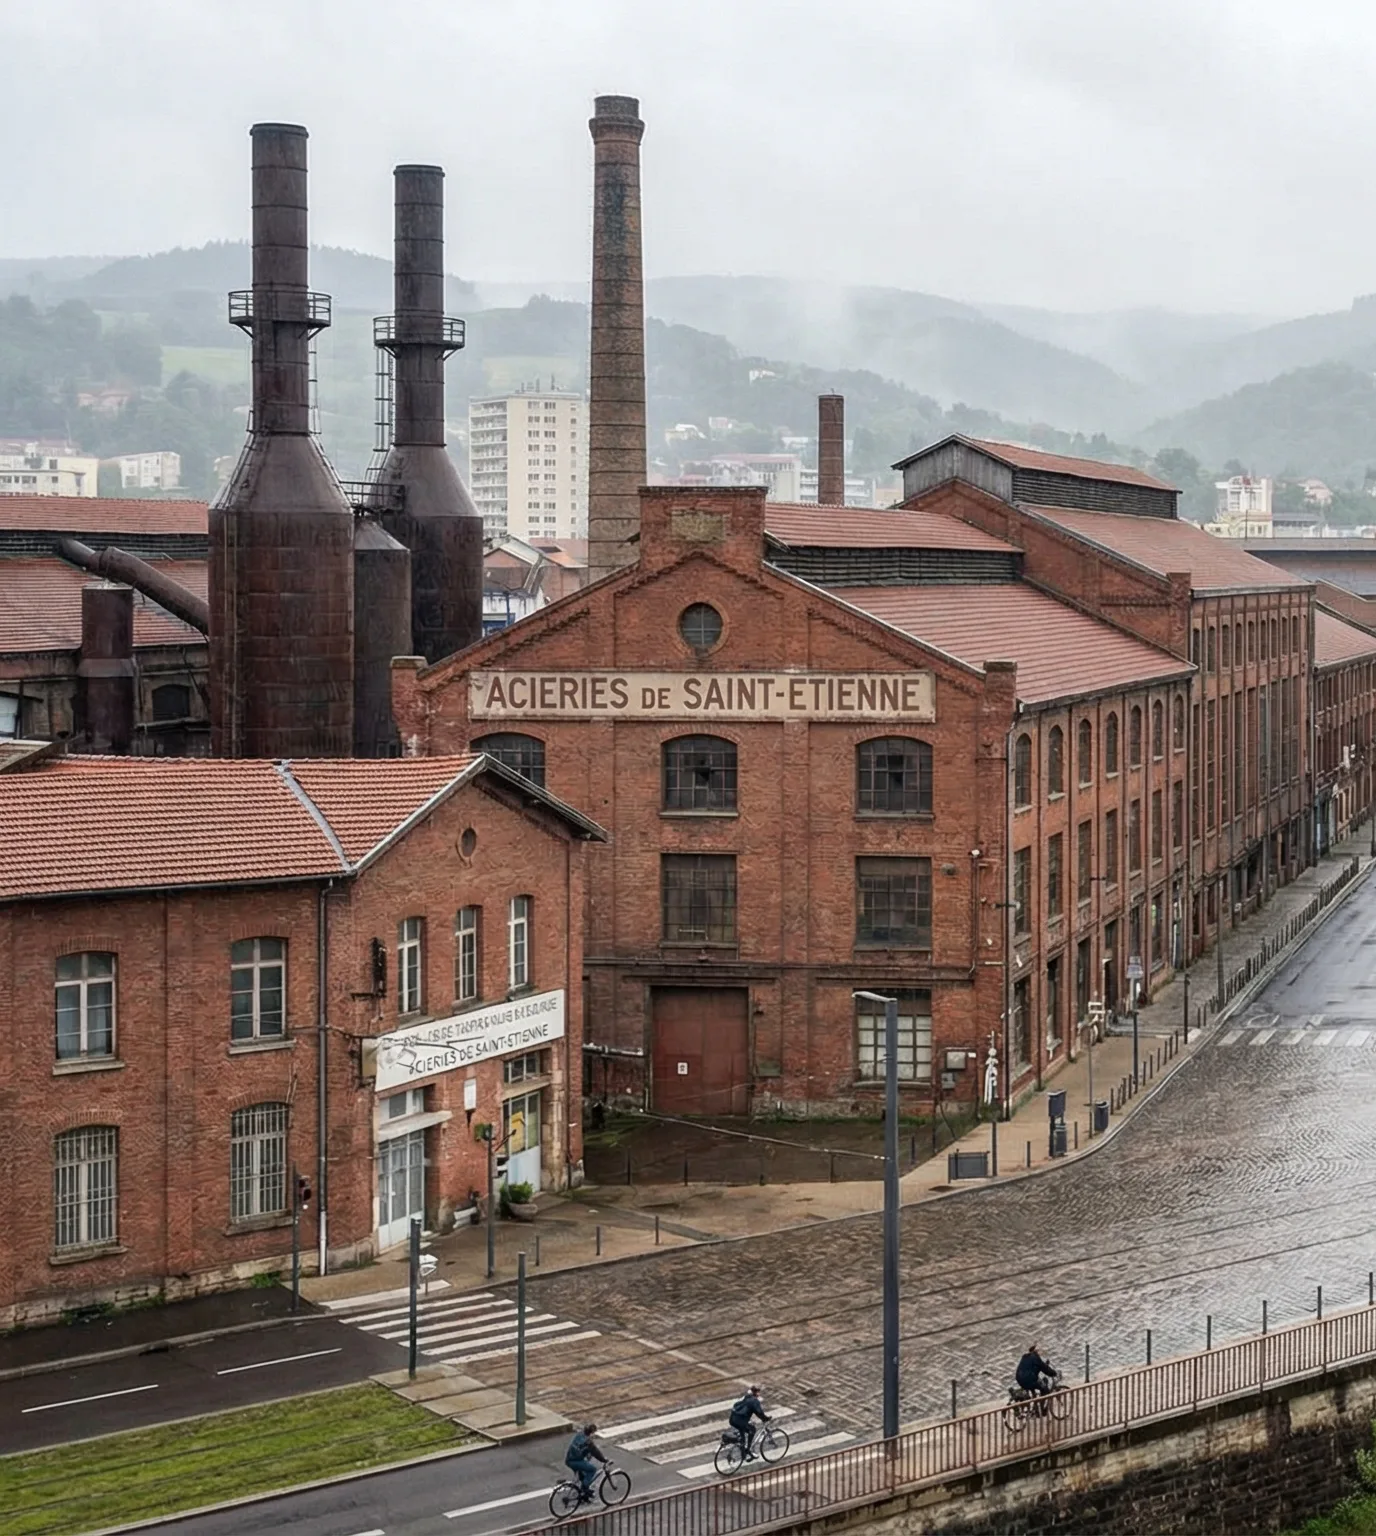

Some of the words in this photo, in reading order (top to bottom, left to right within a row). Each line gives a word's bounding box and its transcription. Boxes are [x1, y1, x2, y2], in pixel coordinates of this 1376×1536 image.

[485, 675, 629, 710] ACIERIES
[641, 687, 671, 710] DE
[683, 677, 920, 711] SAINT-ETIENNE
